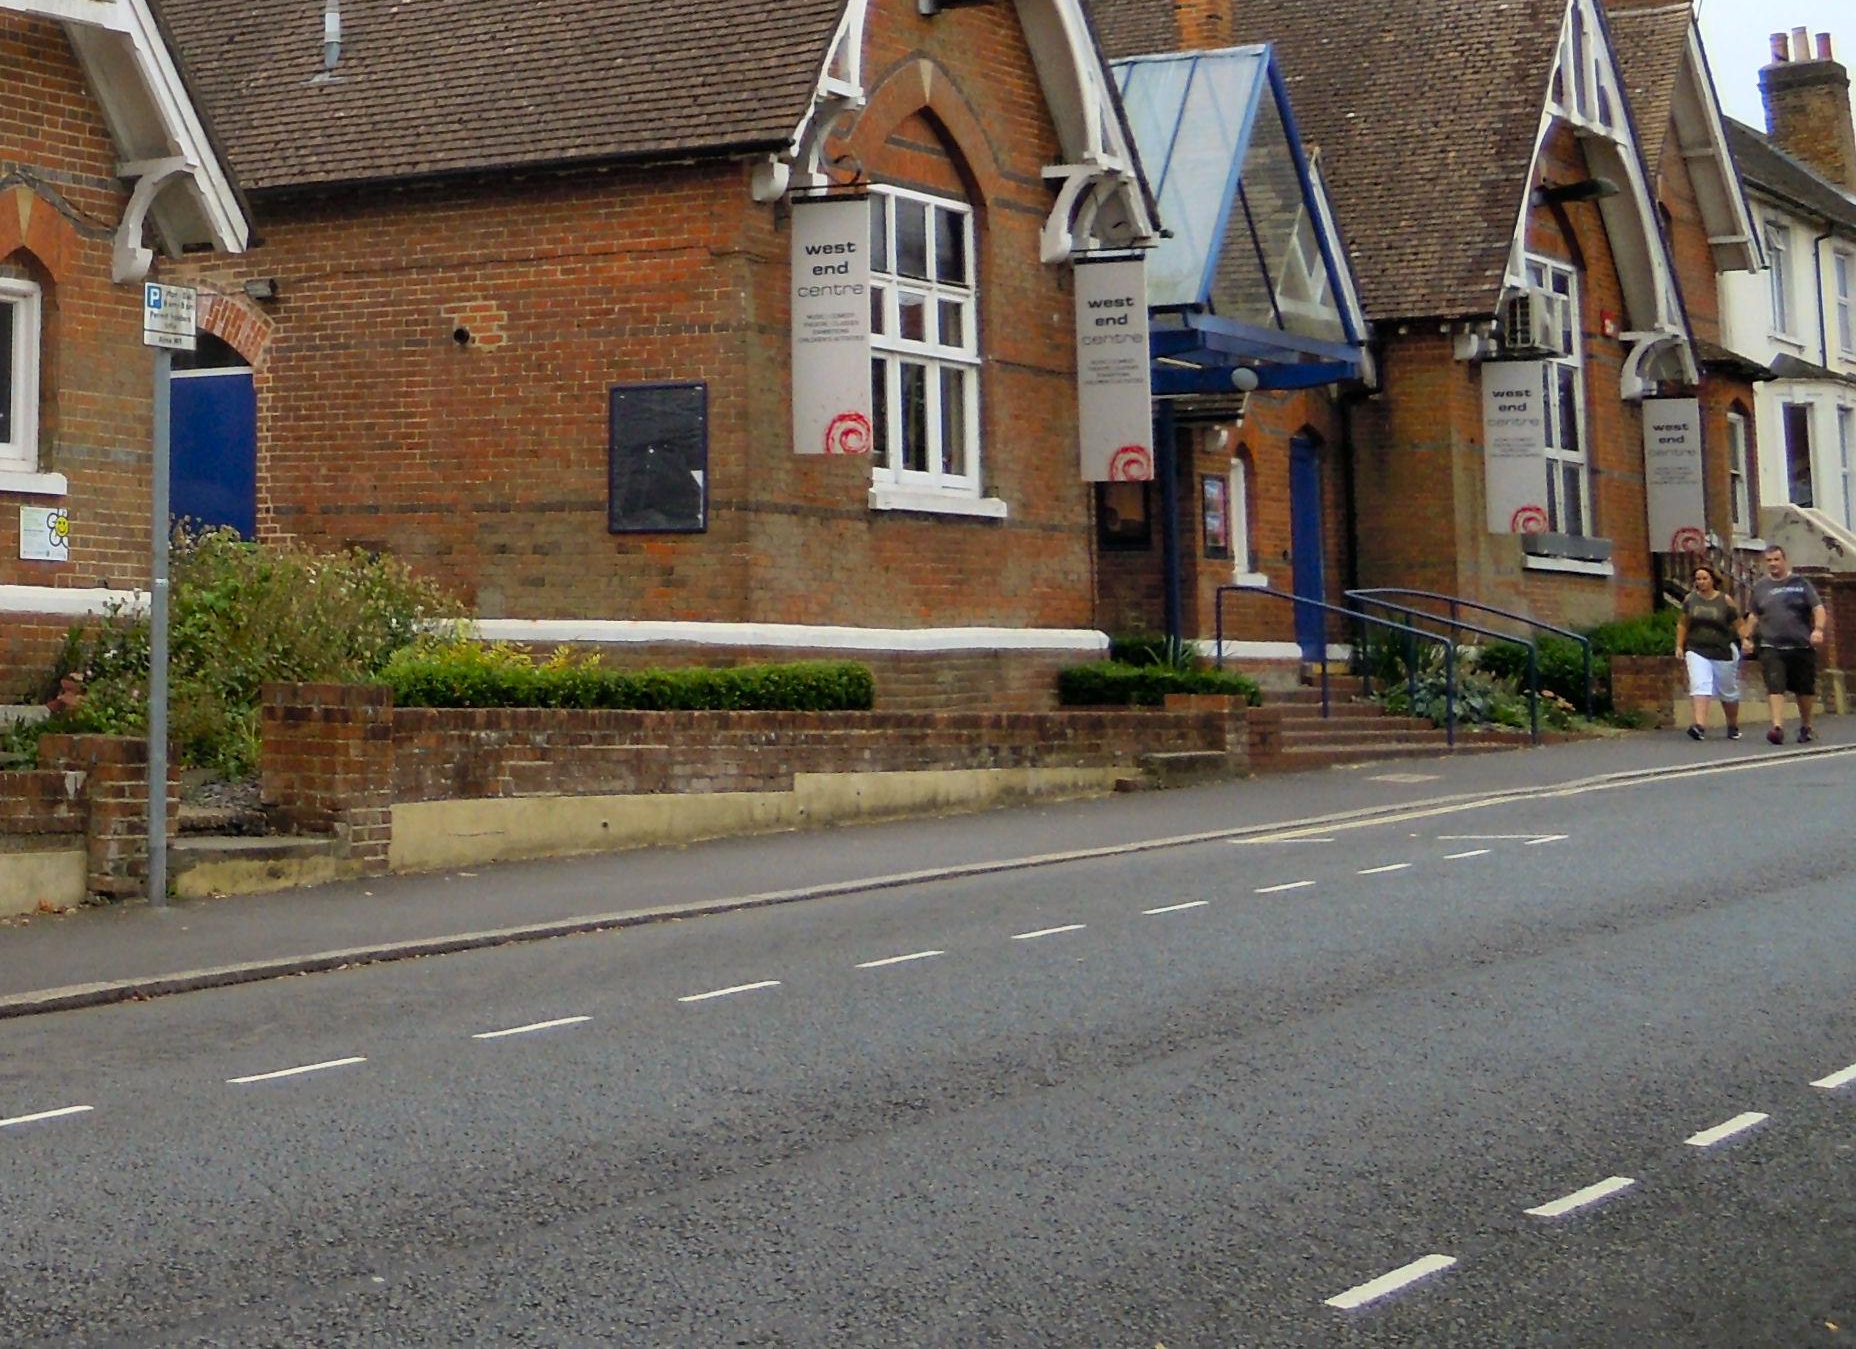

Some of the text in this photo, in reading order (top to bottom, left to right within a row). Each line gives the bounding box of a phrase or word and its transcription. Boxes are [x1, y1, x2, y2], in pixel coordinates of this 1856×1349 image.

[805, 242, 856, 256] west
[812, 261, 849, 275] end
[150, 288, 160, 306] P
[797, 284, 864, 298] centre
[1088, 297, 1134, 308] west
[1095, 313, 1128, 326] end
[1082, 333, 1143, 346] centre
[1492, 389, 1532, 398] west
[1498, 402, 1527, 412] end
[1652, 423, 1689, 431] west
[1658, 435, 1685, 444] end
